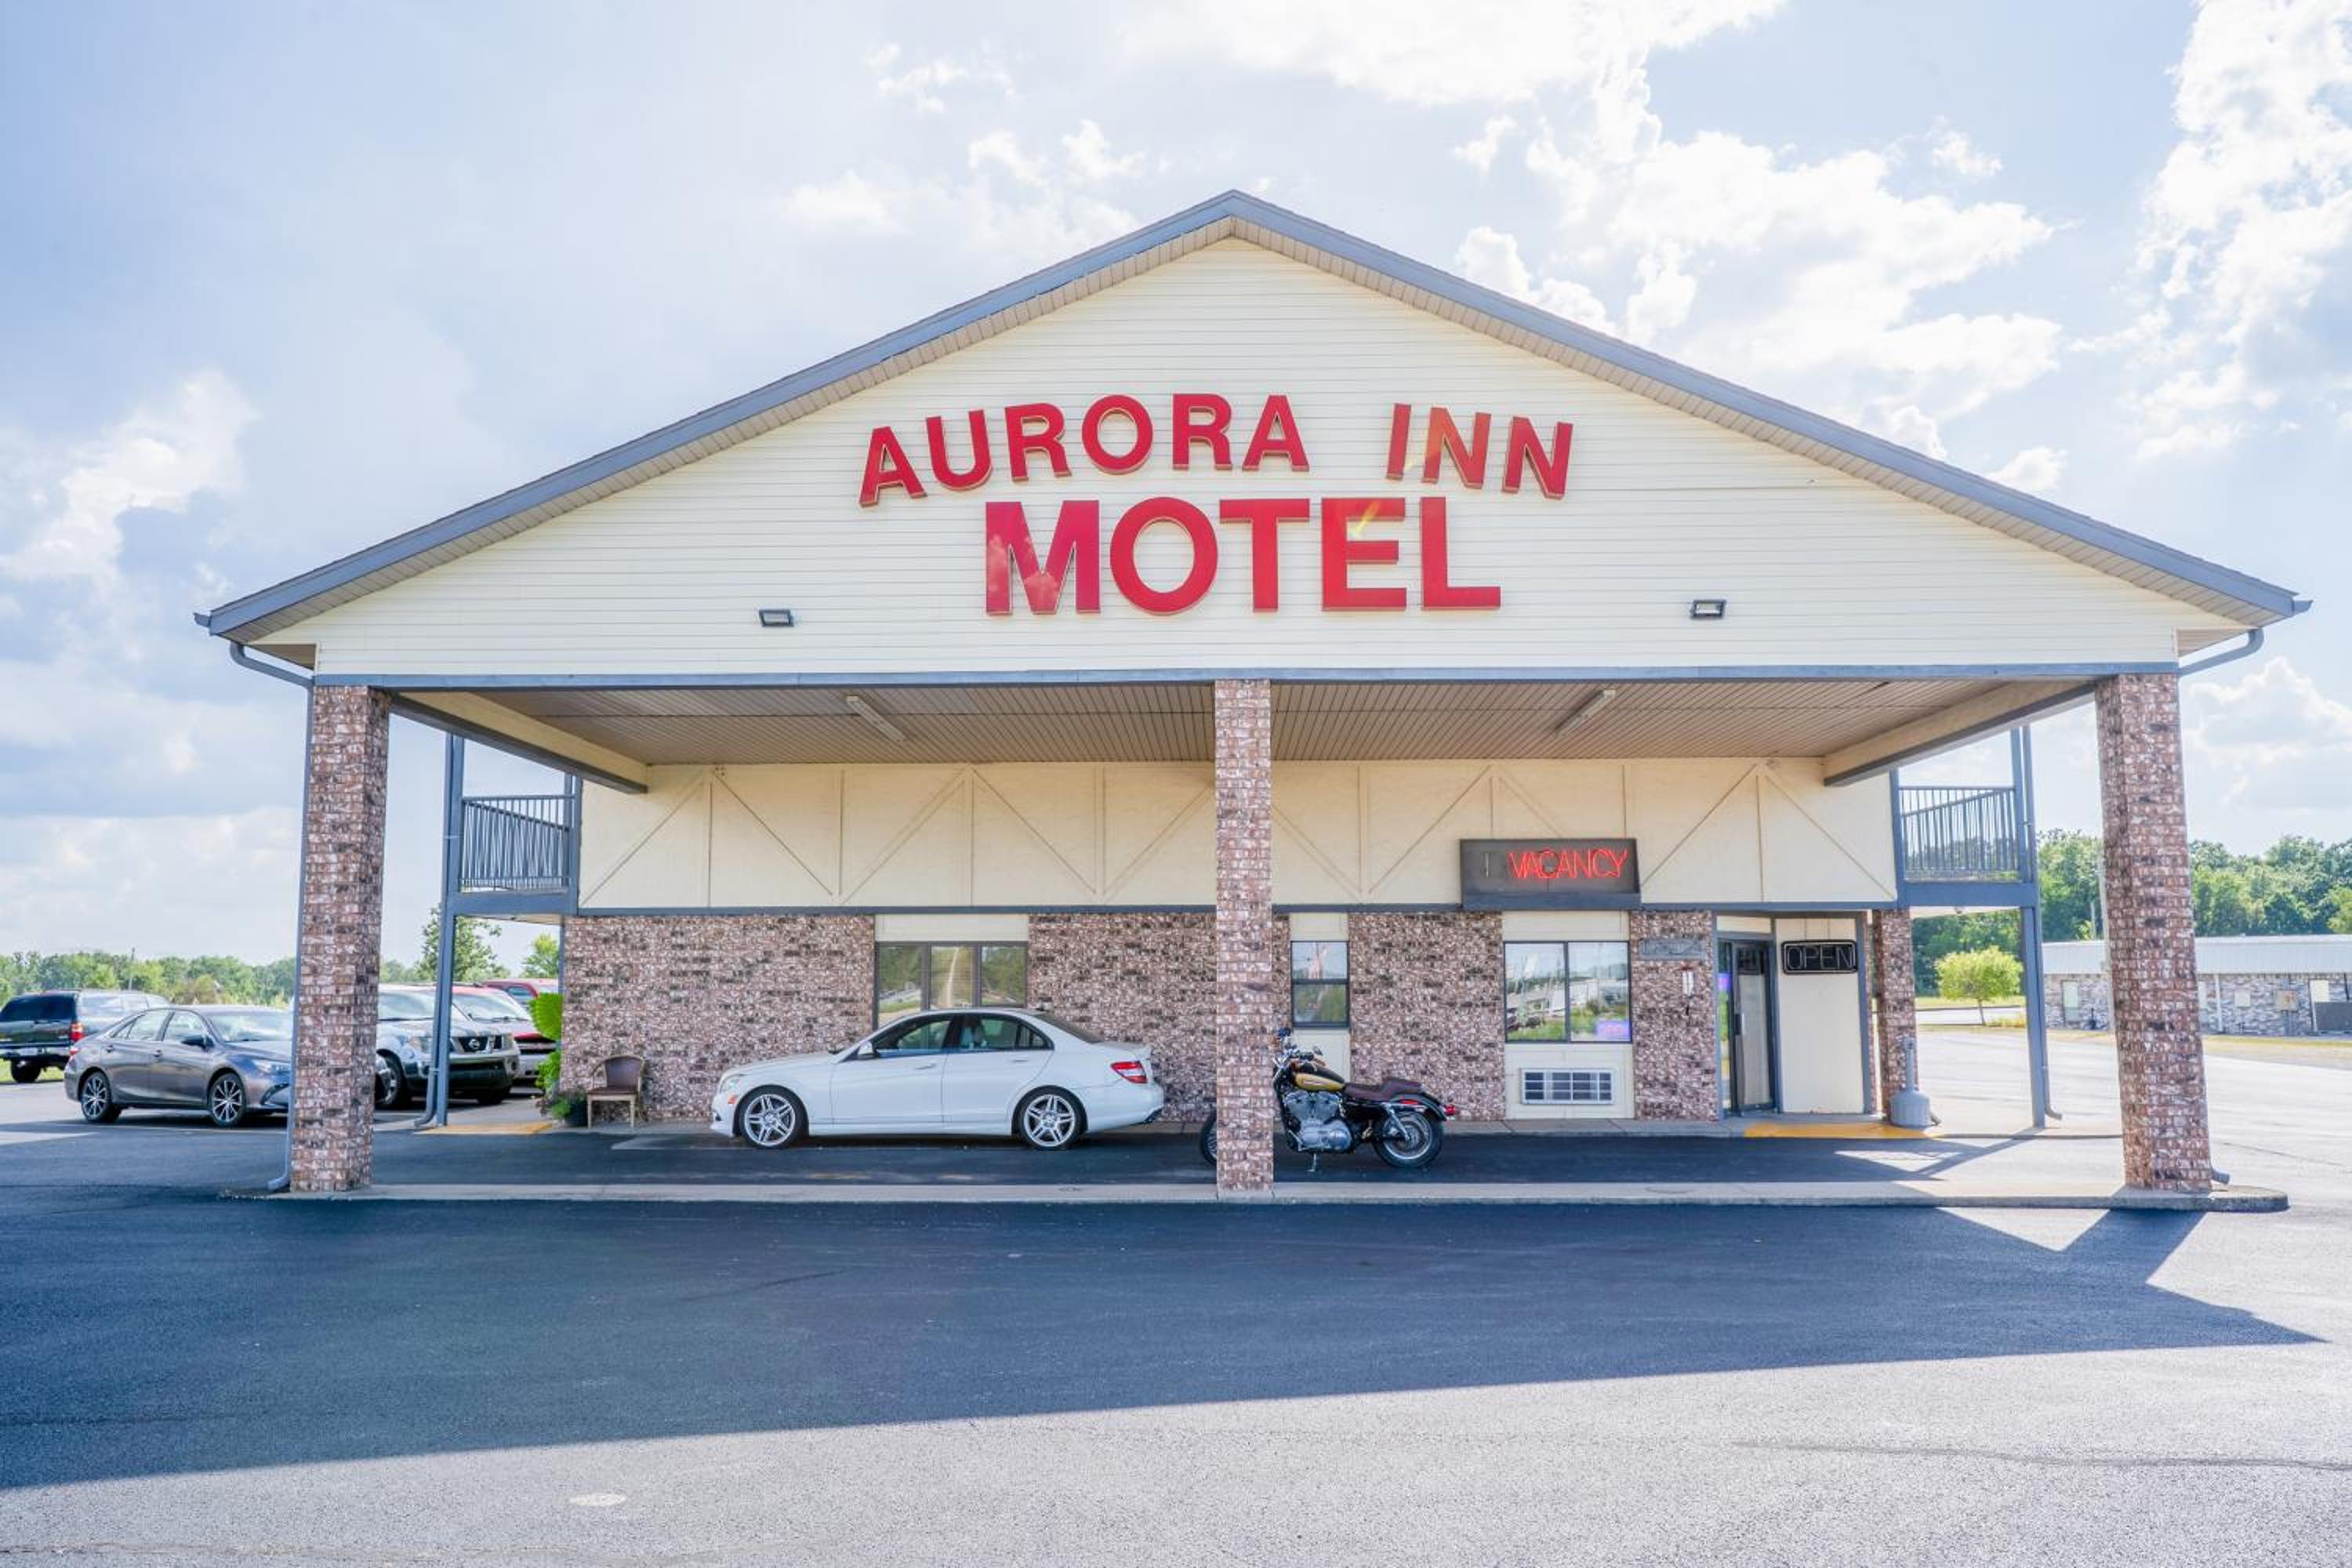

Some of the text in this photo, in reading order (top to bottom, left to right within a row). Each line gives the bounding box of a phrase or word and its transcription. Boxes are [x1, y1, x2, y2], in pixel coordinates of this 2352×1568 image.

[858, 393, 1573, 507] AURORA INN
[985, 496, 1501, 616] MOTEL
[1508, 847, 1629, 879] VACANCY
[1786, 945, 1854, 971] OPEN
